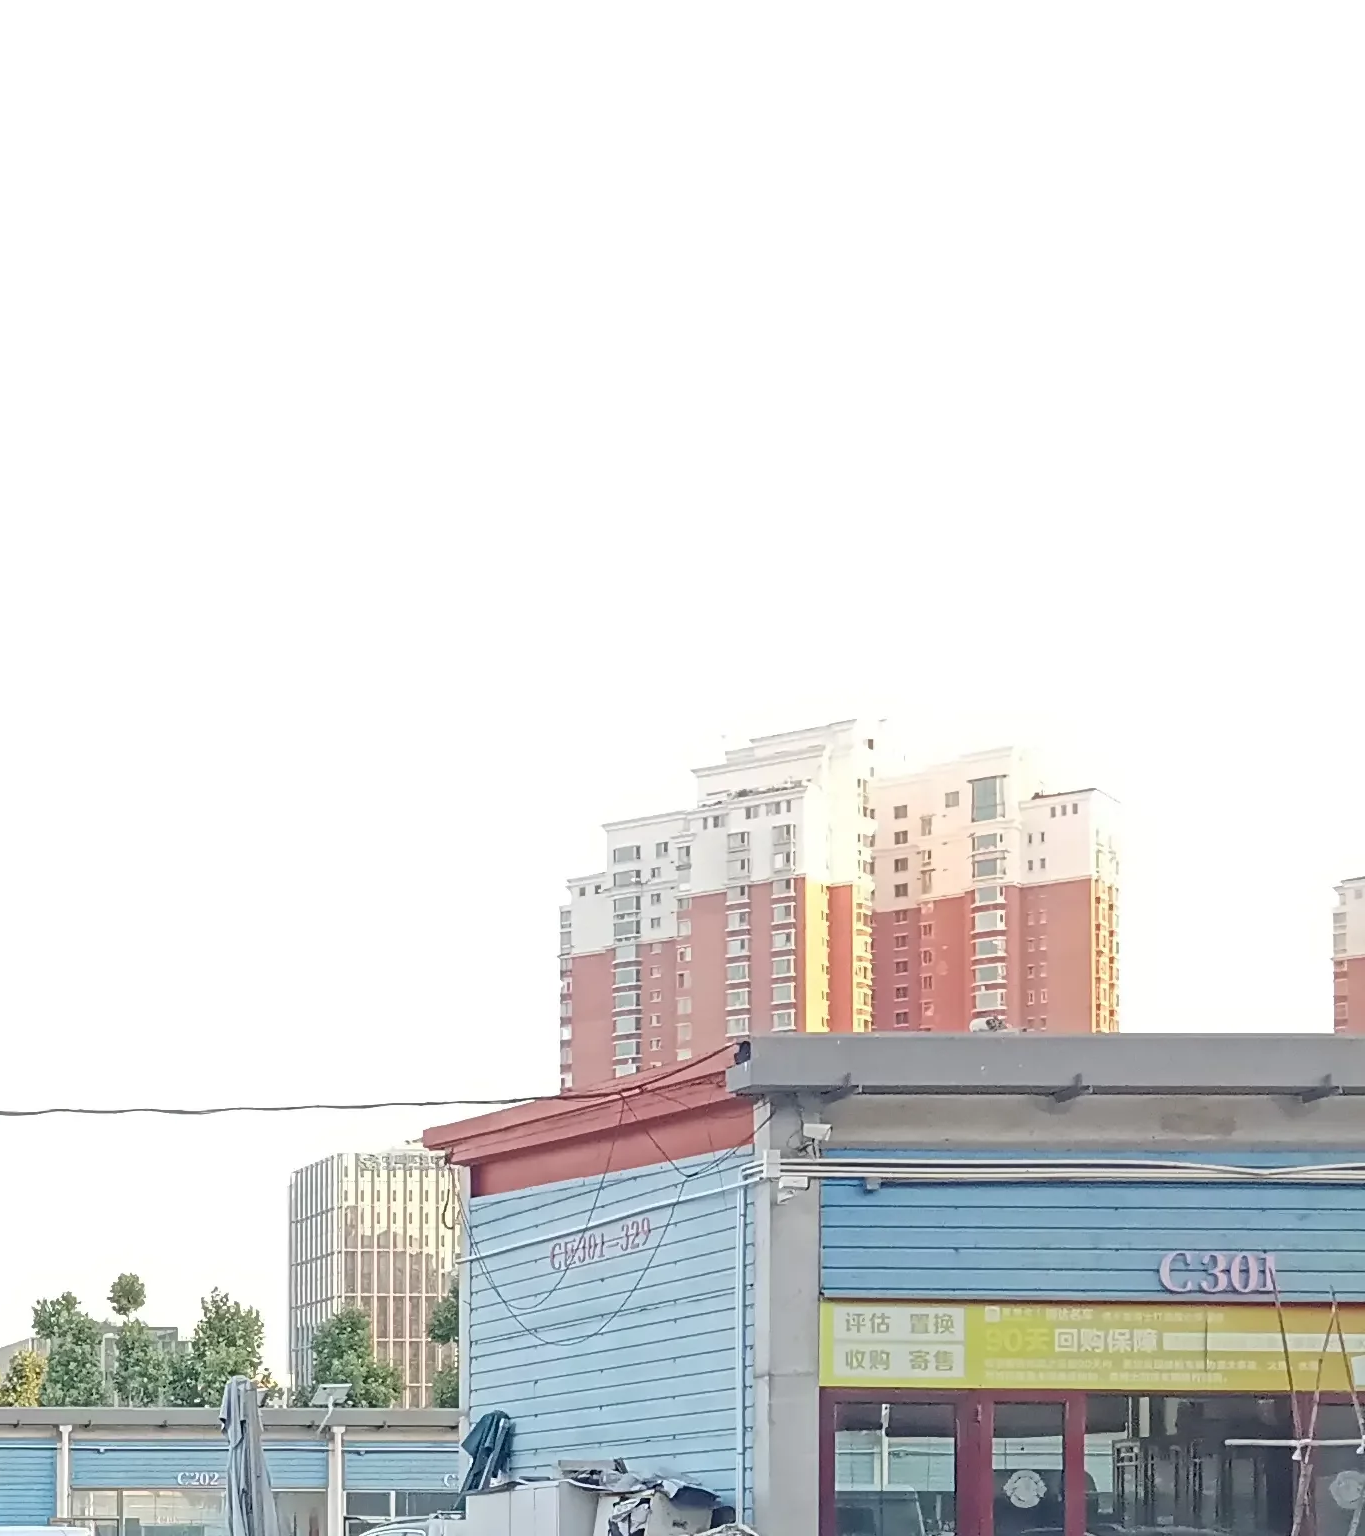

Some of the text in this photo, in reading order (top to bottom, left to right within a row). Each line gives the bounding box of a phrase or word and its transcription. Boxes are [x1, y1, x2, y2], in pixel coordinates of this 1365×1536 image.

[1158, 1251, 1276, 1293] C301
[845, 1313, 954, 1334] 评估 置换
[845, 1350, 954, 1371] 收购 寄售
[177, 1471, 220, 1486] C202
